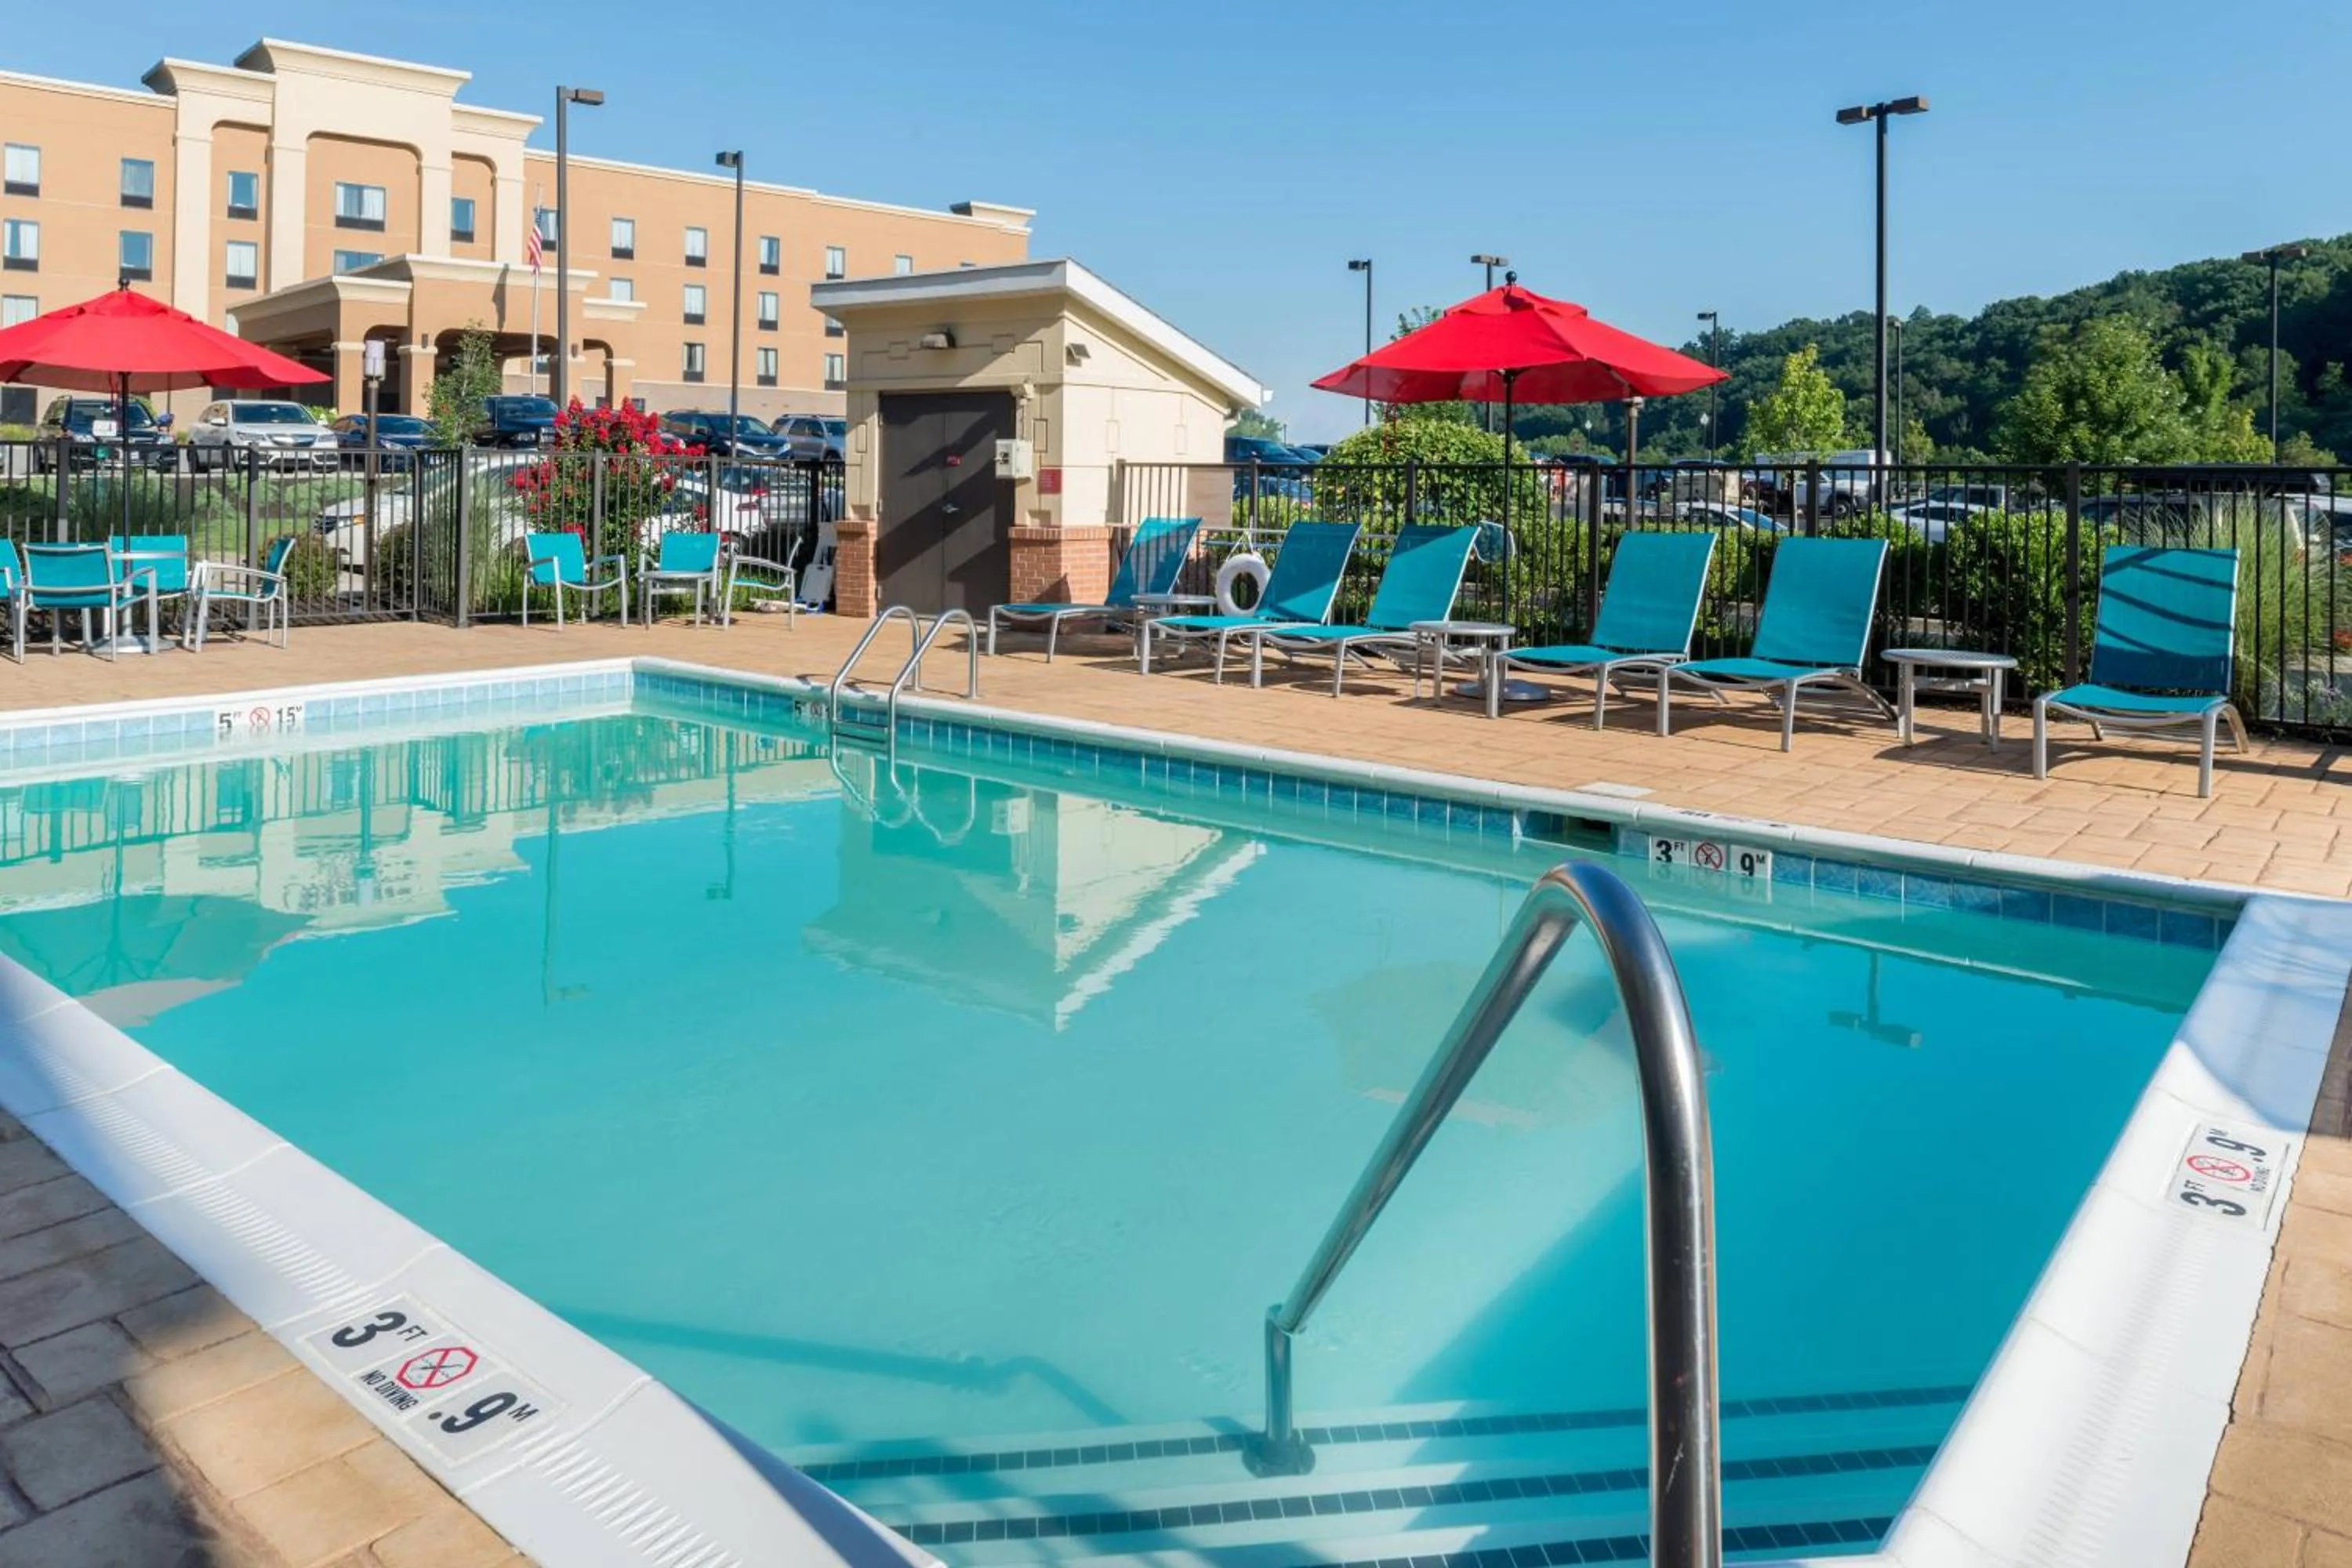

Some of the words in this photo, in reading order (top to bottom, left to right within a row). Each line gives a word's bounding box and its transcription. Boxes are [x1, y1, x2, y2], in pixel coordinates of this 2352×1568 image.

[219, 712, 233, 729] 5
[1656, 840, 1672, 863] 3
[1674, 842, 1686, 852] FT
[1755, 855, 1766, 865] M
[2184, 1179, 2205, 1192] FT
[2180, 1192, 2247, 1217] 3
[332, 1311, 407, 1348] 3
[397, 1325, 428, 1341] FT
[360, 1370, 387, 1386] NO
[374, 1381, 419, 1410] DIVING
[508, 1403, 539, 1422] M
